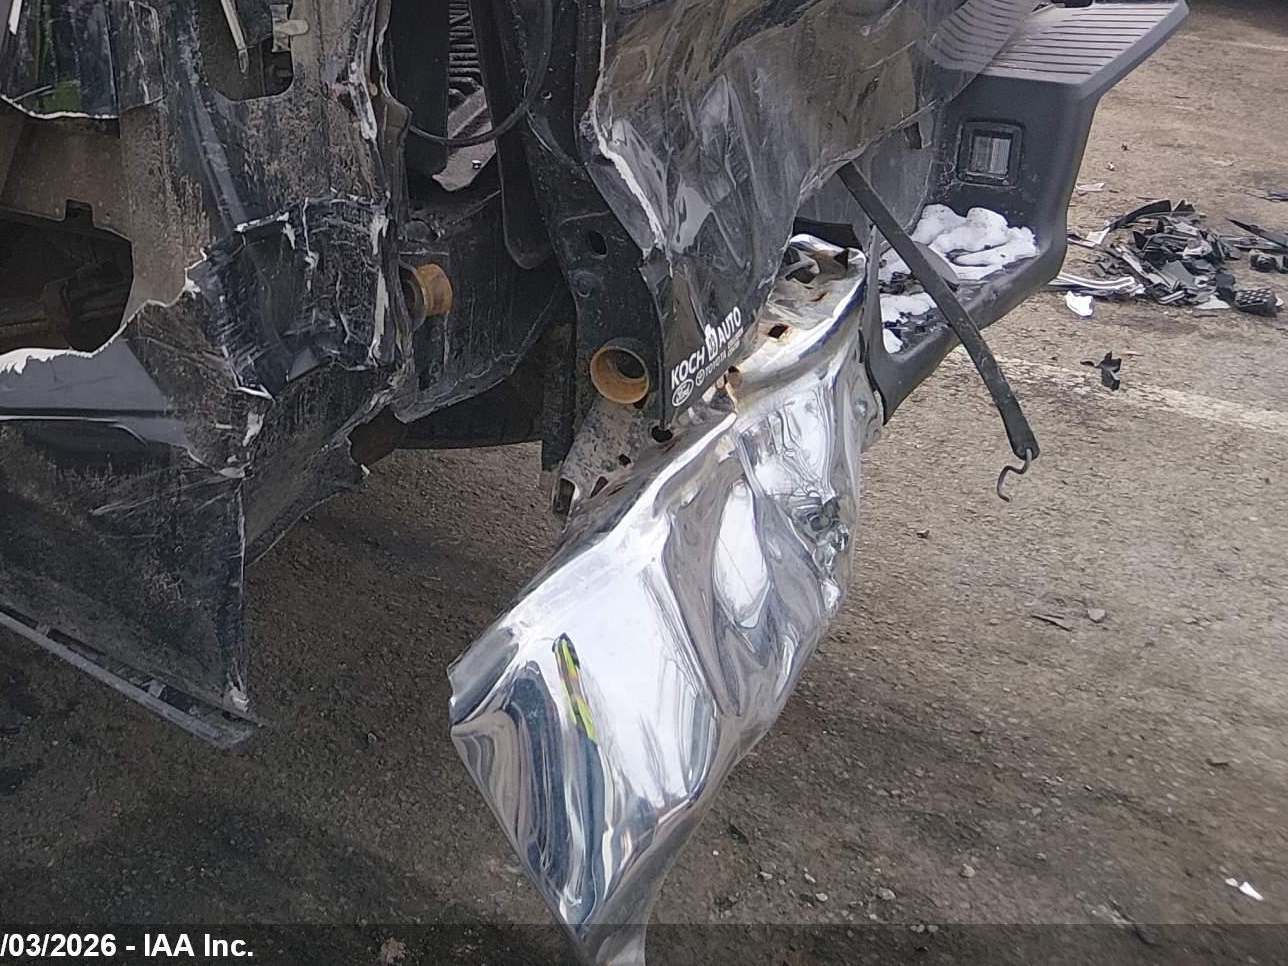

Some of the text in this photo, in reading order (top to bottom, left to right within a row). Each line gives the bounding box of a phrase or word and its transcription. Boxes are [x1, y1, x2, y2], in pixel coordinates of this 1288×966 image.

[671, 345, 706, 390] KOCH
[717, 306, 742, 348] AUTO
[704, 350, 727, 376] TOYOTA
